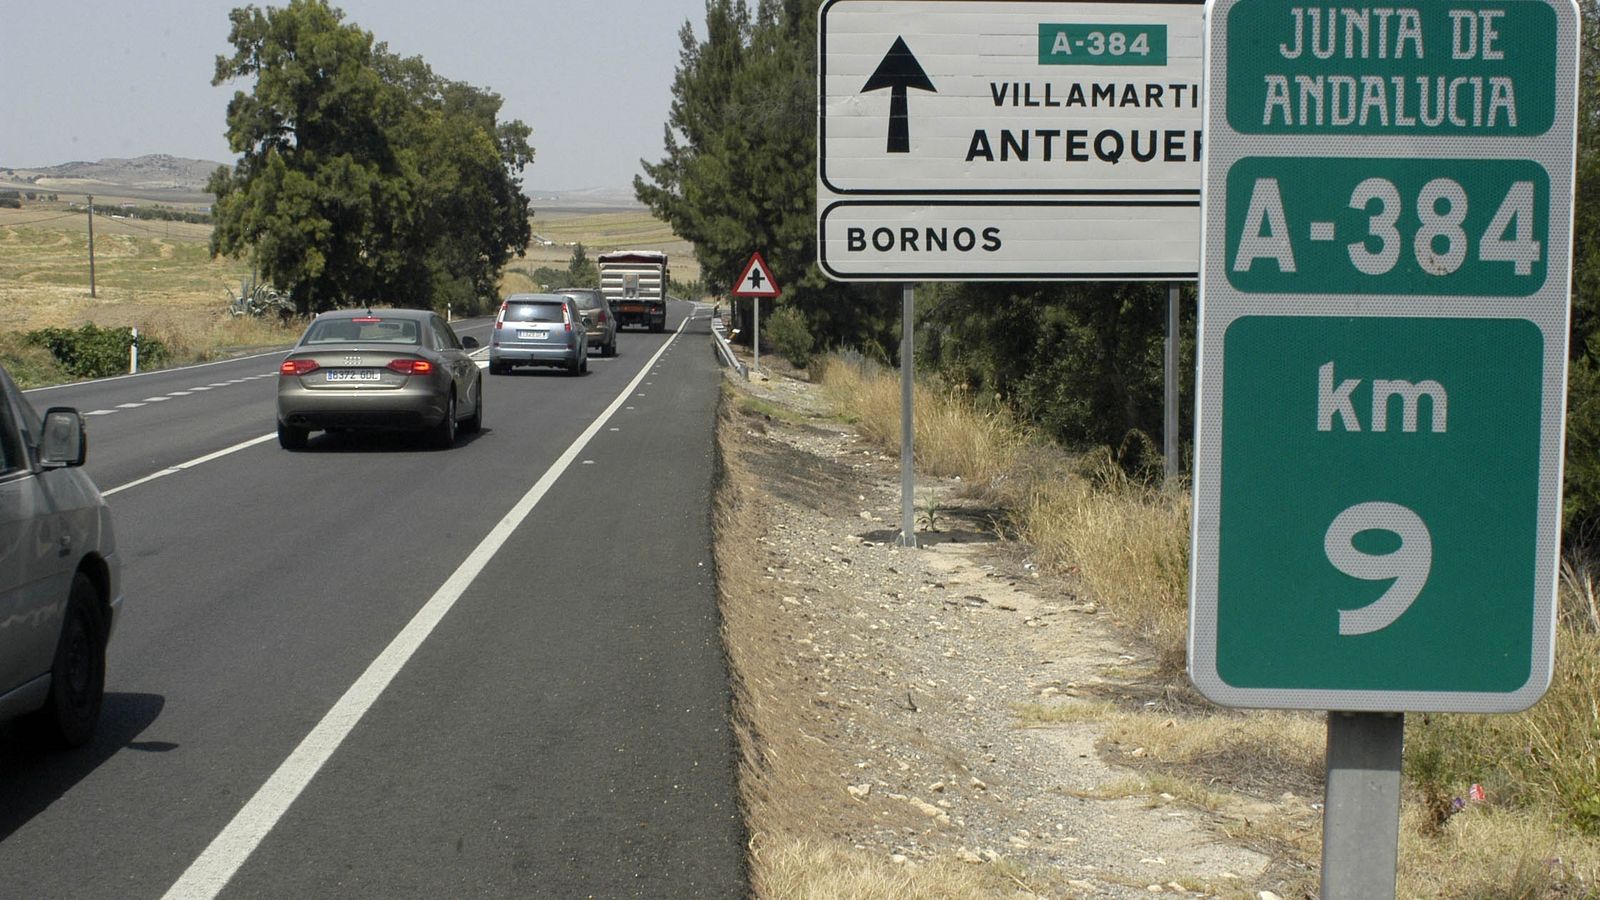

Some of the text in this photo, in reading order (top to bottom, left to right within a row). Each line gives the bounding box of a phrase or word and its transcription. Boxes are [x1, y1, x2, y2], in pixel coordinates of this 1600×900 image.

[1051, 31, 1150, 57] A-384
[1279, 7, 1505, 60] JUNTA DE
[990, 82, 1198, 108] VILLAMARTI
[1262, 75, 1518, 127] ANDALUCIA
[847, 227, 1002, 252] BORNOS
[1233, 177, 1541, 276] A-384
[1316, 360, 1448, 433] km
[1323, 500, 1433, 636] 9
